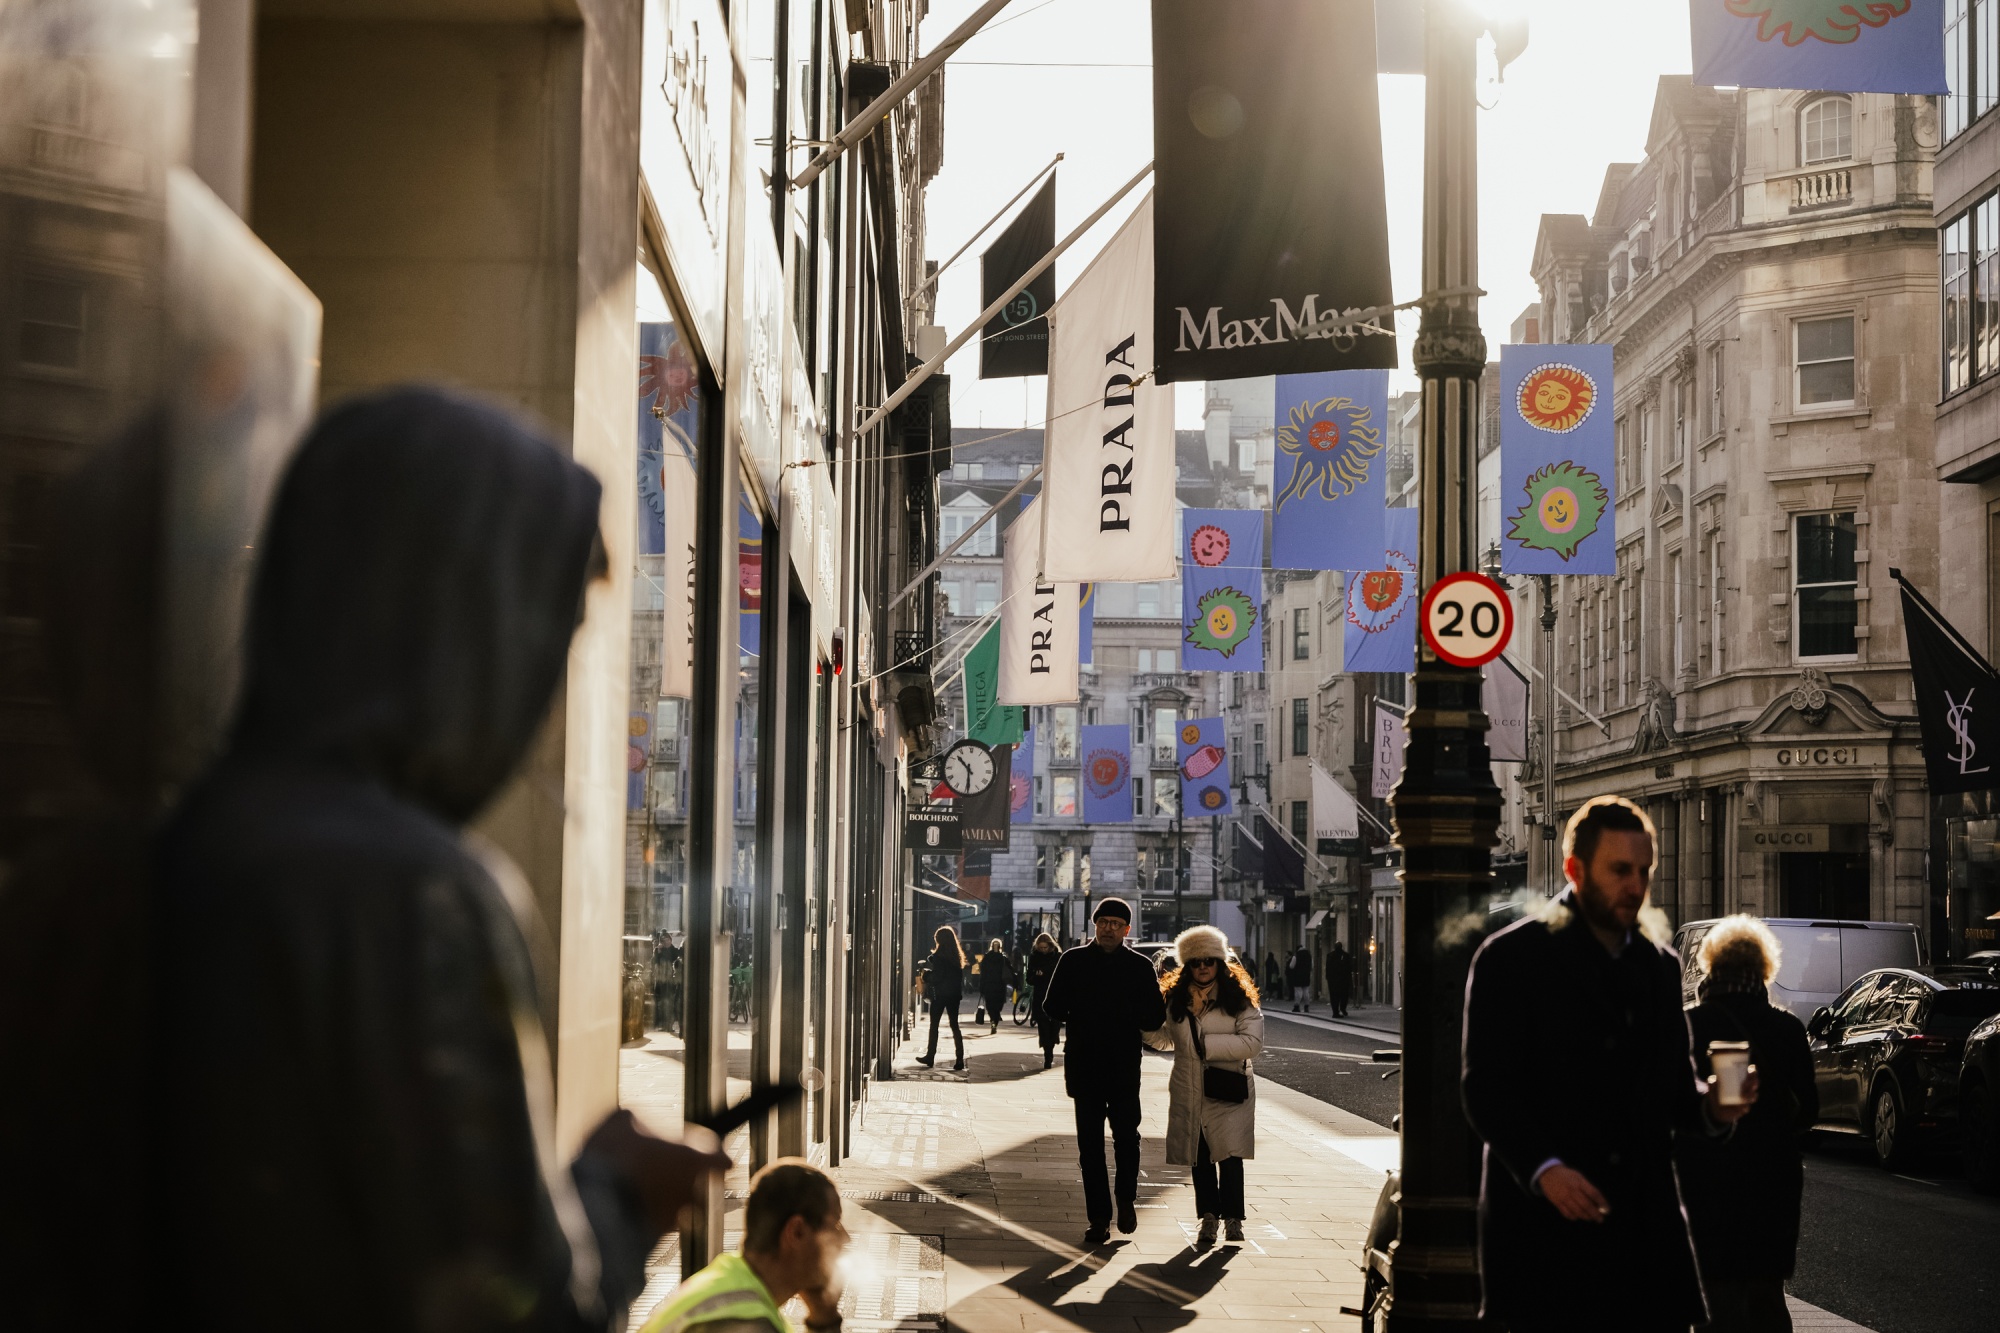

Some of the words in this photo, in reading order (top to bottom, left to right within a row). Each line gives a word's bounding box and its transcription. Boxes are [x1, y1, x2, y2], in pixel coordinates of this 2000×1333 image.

[1009, 299, 1029, 317] 15
[1174, 293, 1384, 352] MaxMara
[1026, 333, 1048, 341] STREET
[1100, 331, 1136, 535] PRADA
[1437, 600, 1500, 639] 20
[975, 671, 988, 731] BOTTEGA
[1379, 719, 1393, 780] BRUN
[1776, 747, 1858, 765] GUCCI
[909, 813, 959, 822] BOUCHERON
[1316, 829, 1358, 838] VALENTINO
[1754, 832, 1813, 845] GUCCI
